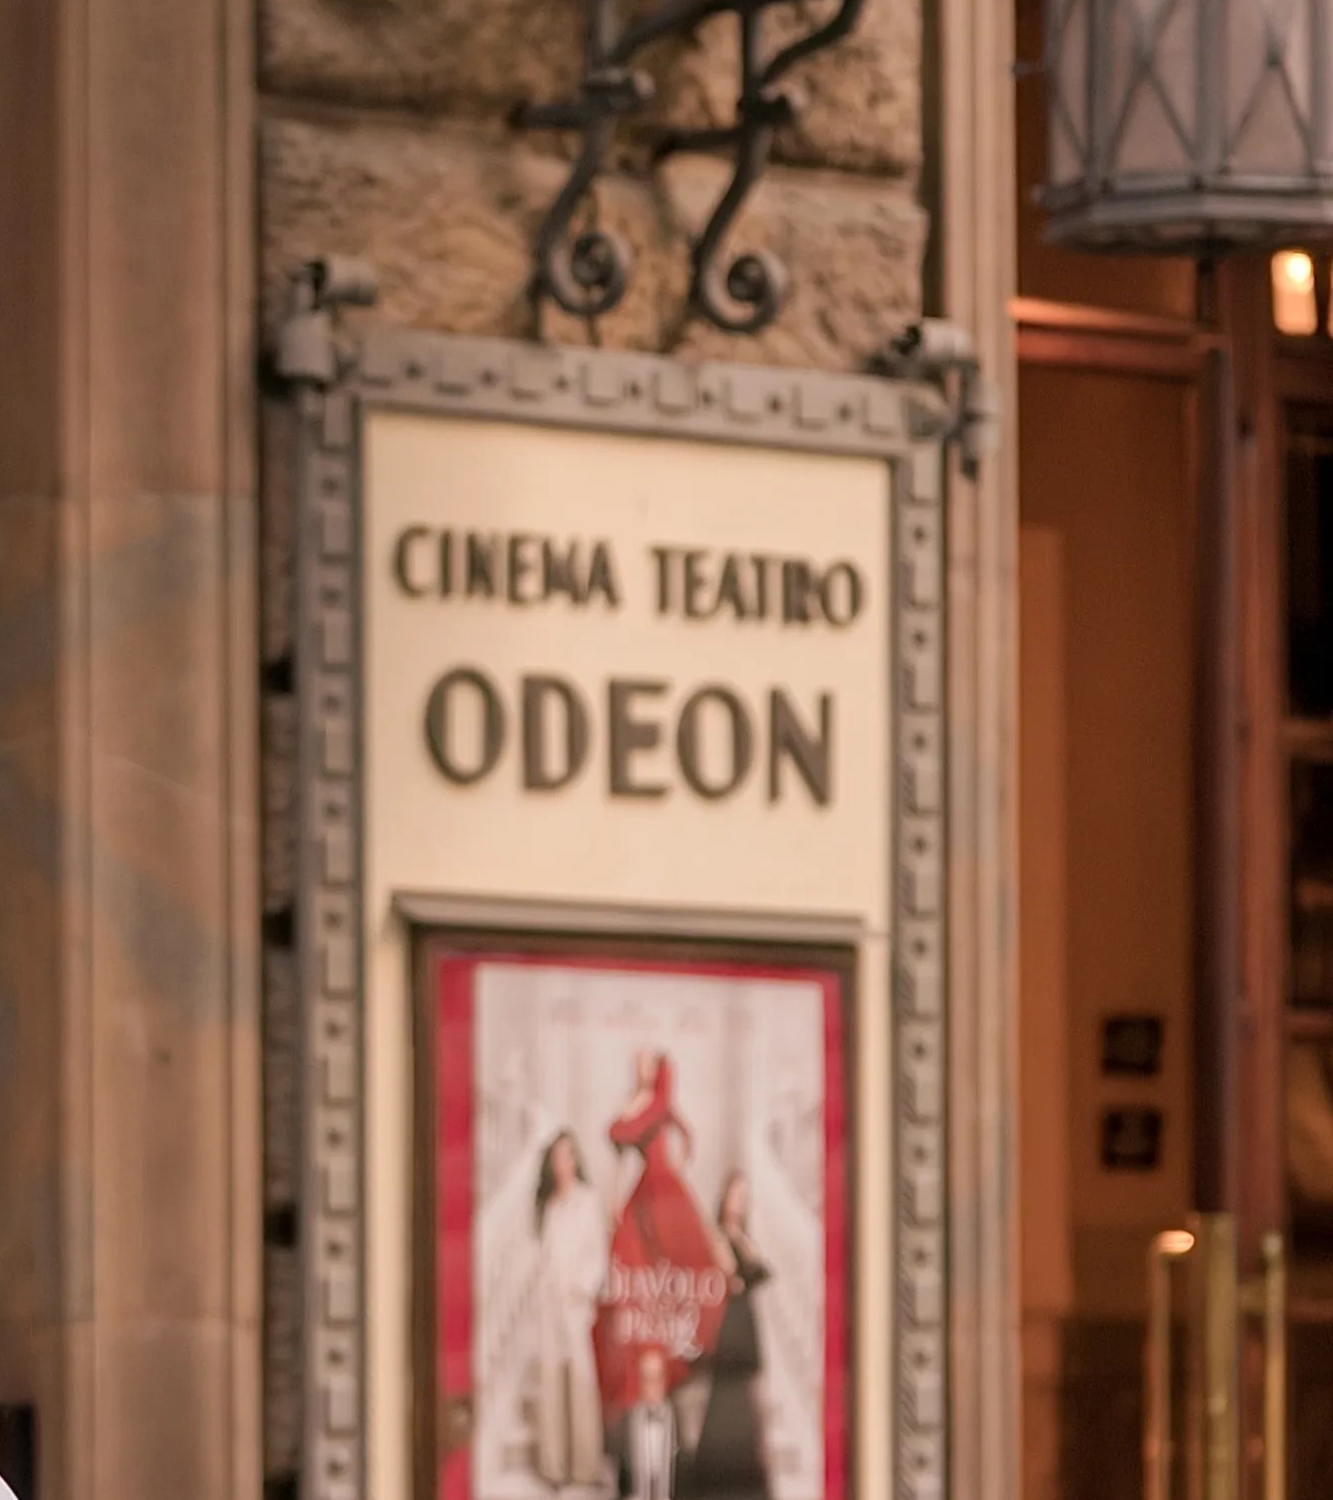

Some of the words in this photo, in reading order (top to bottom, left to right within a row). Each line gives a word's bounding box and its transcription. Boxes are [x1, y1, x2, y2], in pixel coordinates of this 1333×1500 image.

[393, 524, 620, 608] CINEMA
[650, 543, 864, 628] TEATRO
[424, 666, 835, 810] ODEON
